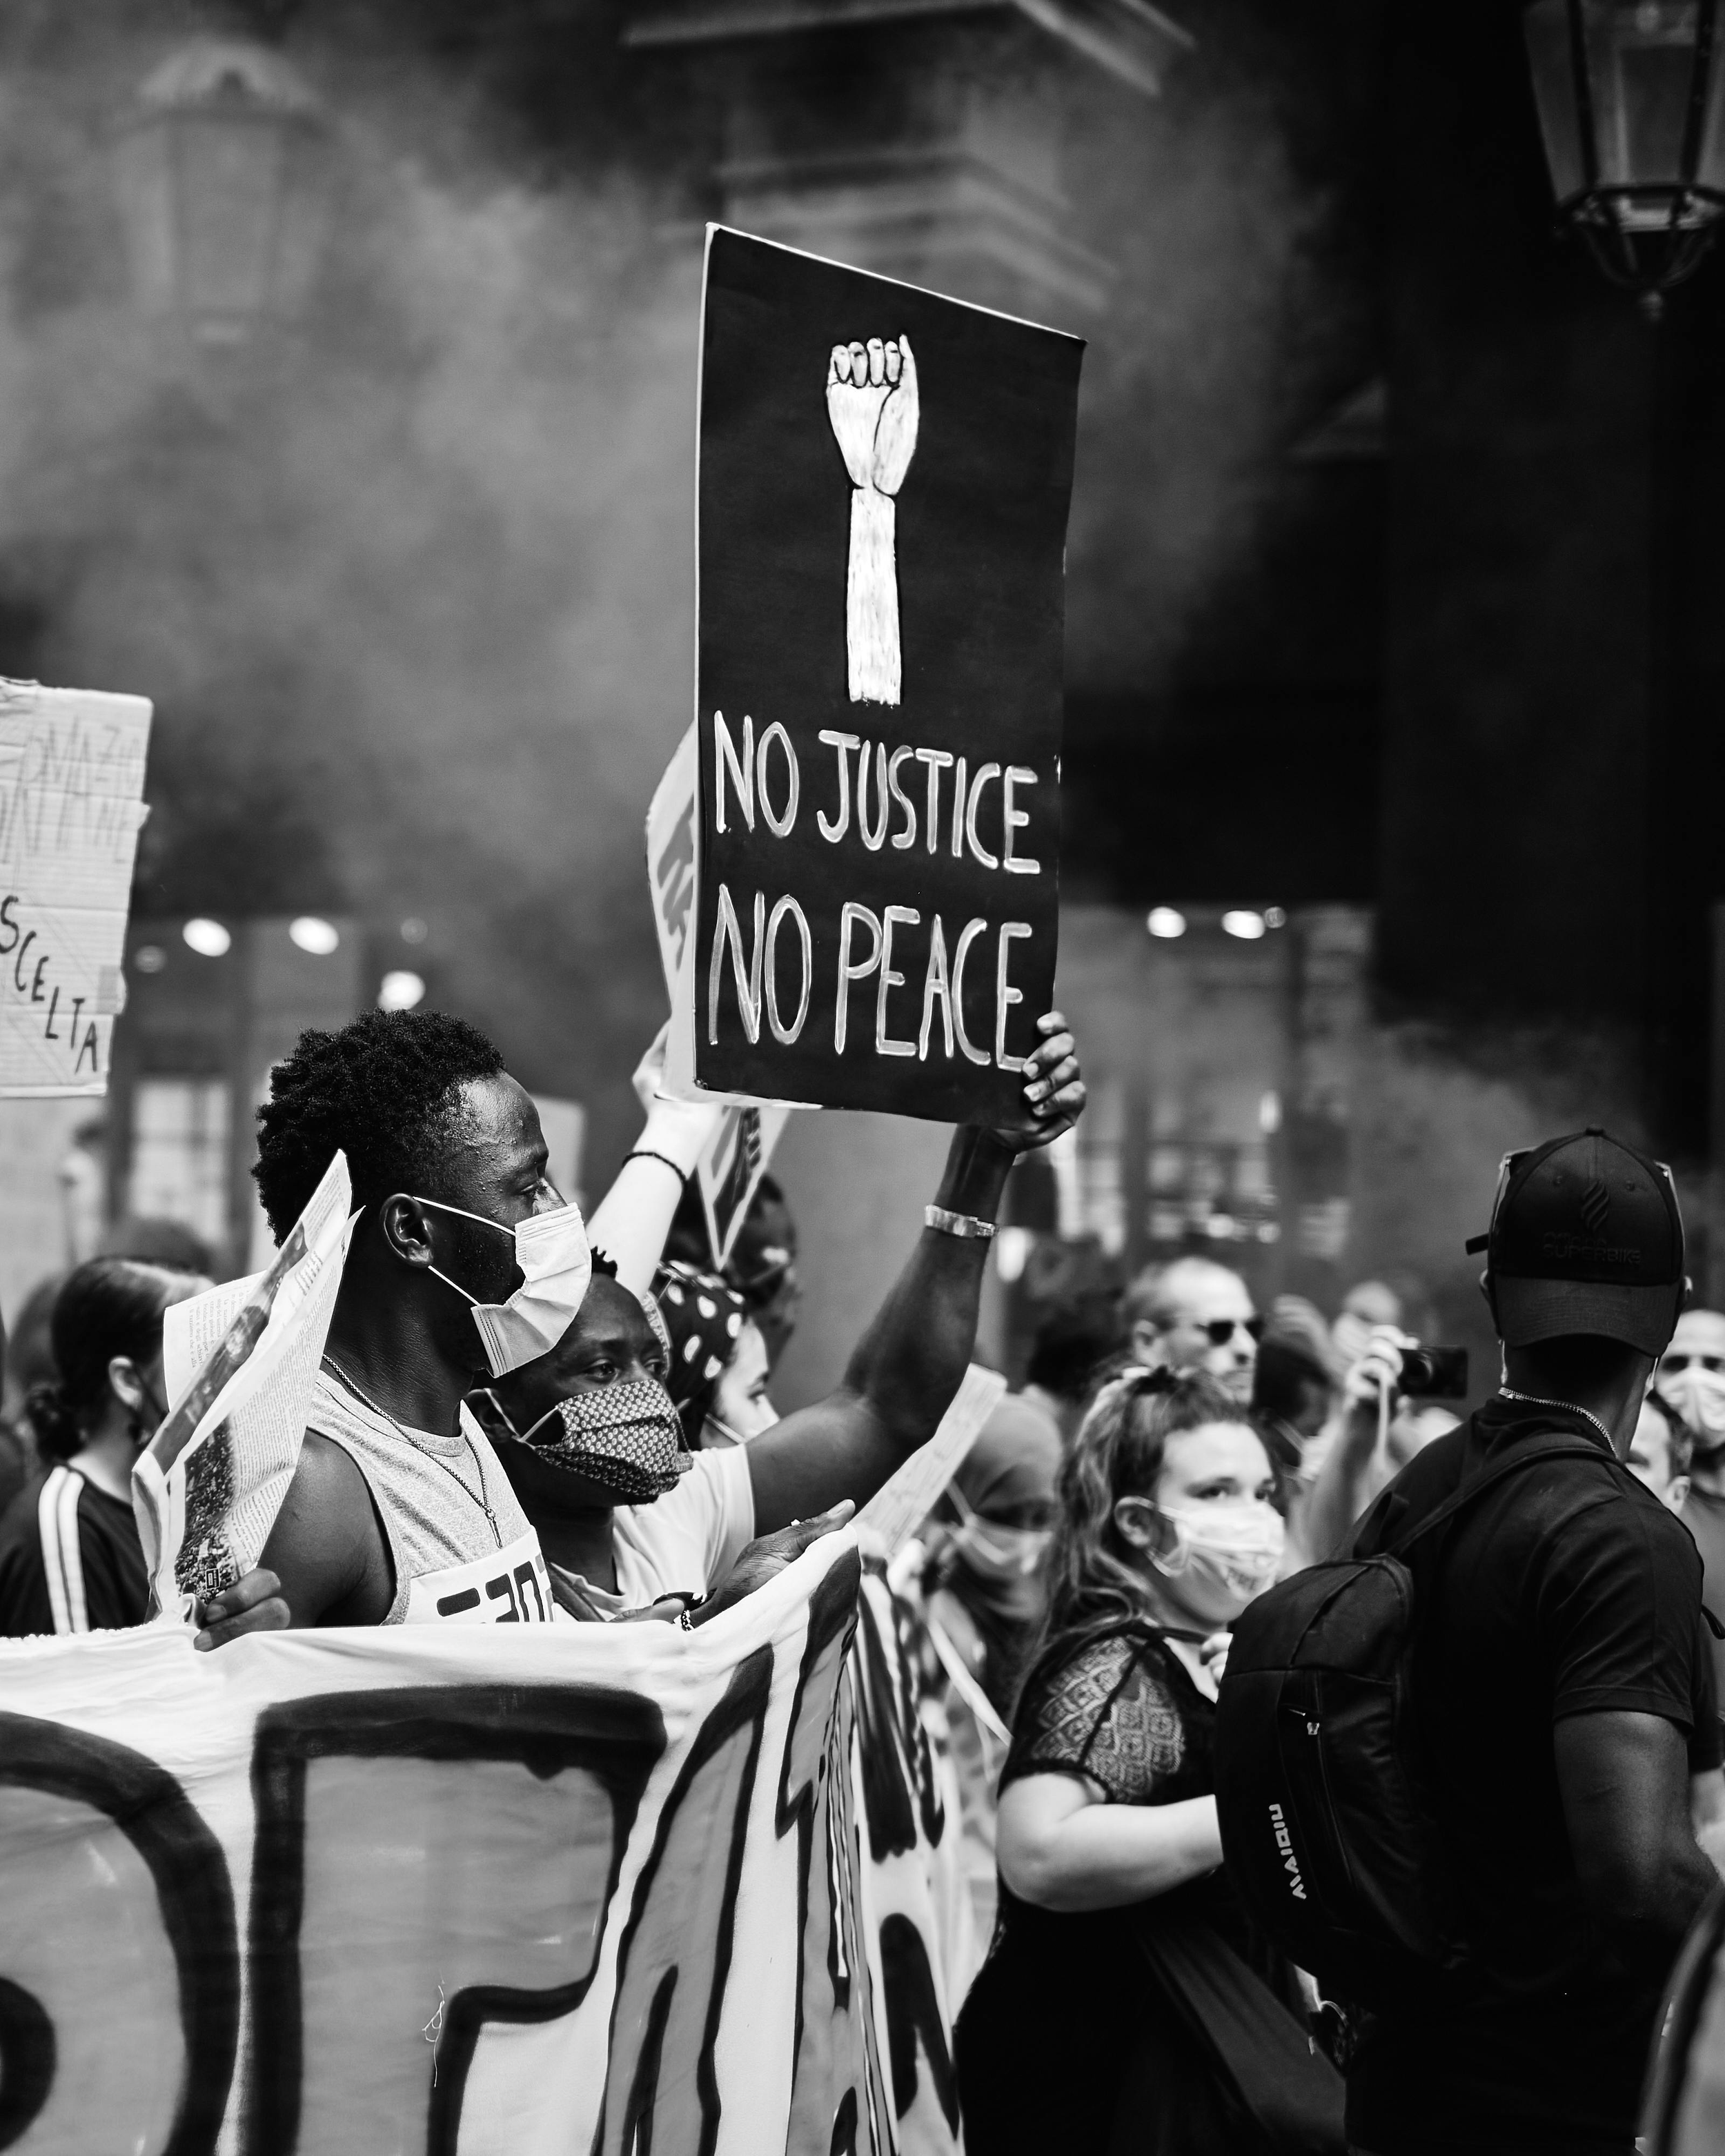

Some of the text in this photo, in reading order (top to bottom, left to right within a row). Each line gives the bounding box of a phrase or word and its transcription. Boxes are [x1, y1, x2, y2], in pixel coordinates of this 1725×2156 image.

[713, 710, 1041, 874] NO JUSTICE
[708, 883, 1032, 1072] NO PEACE
